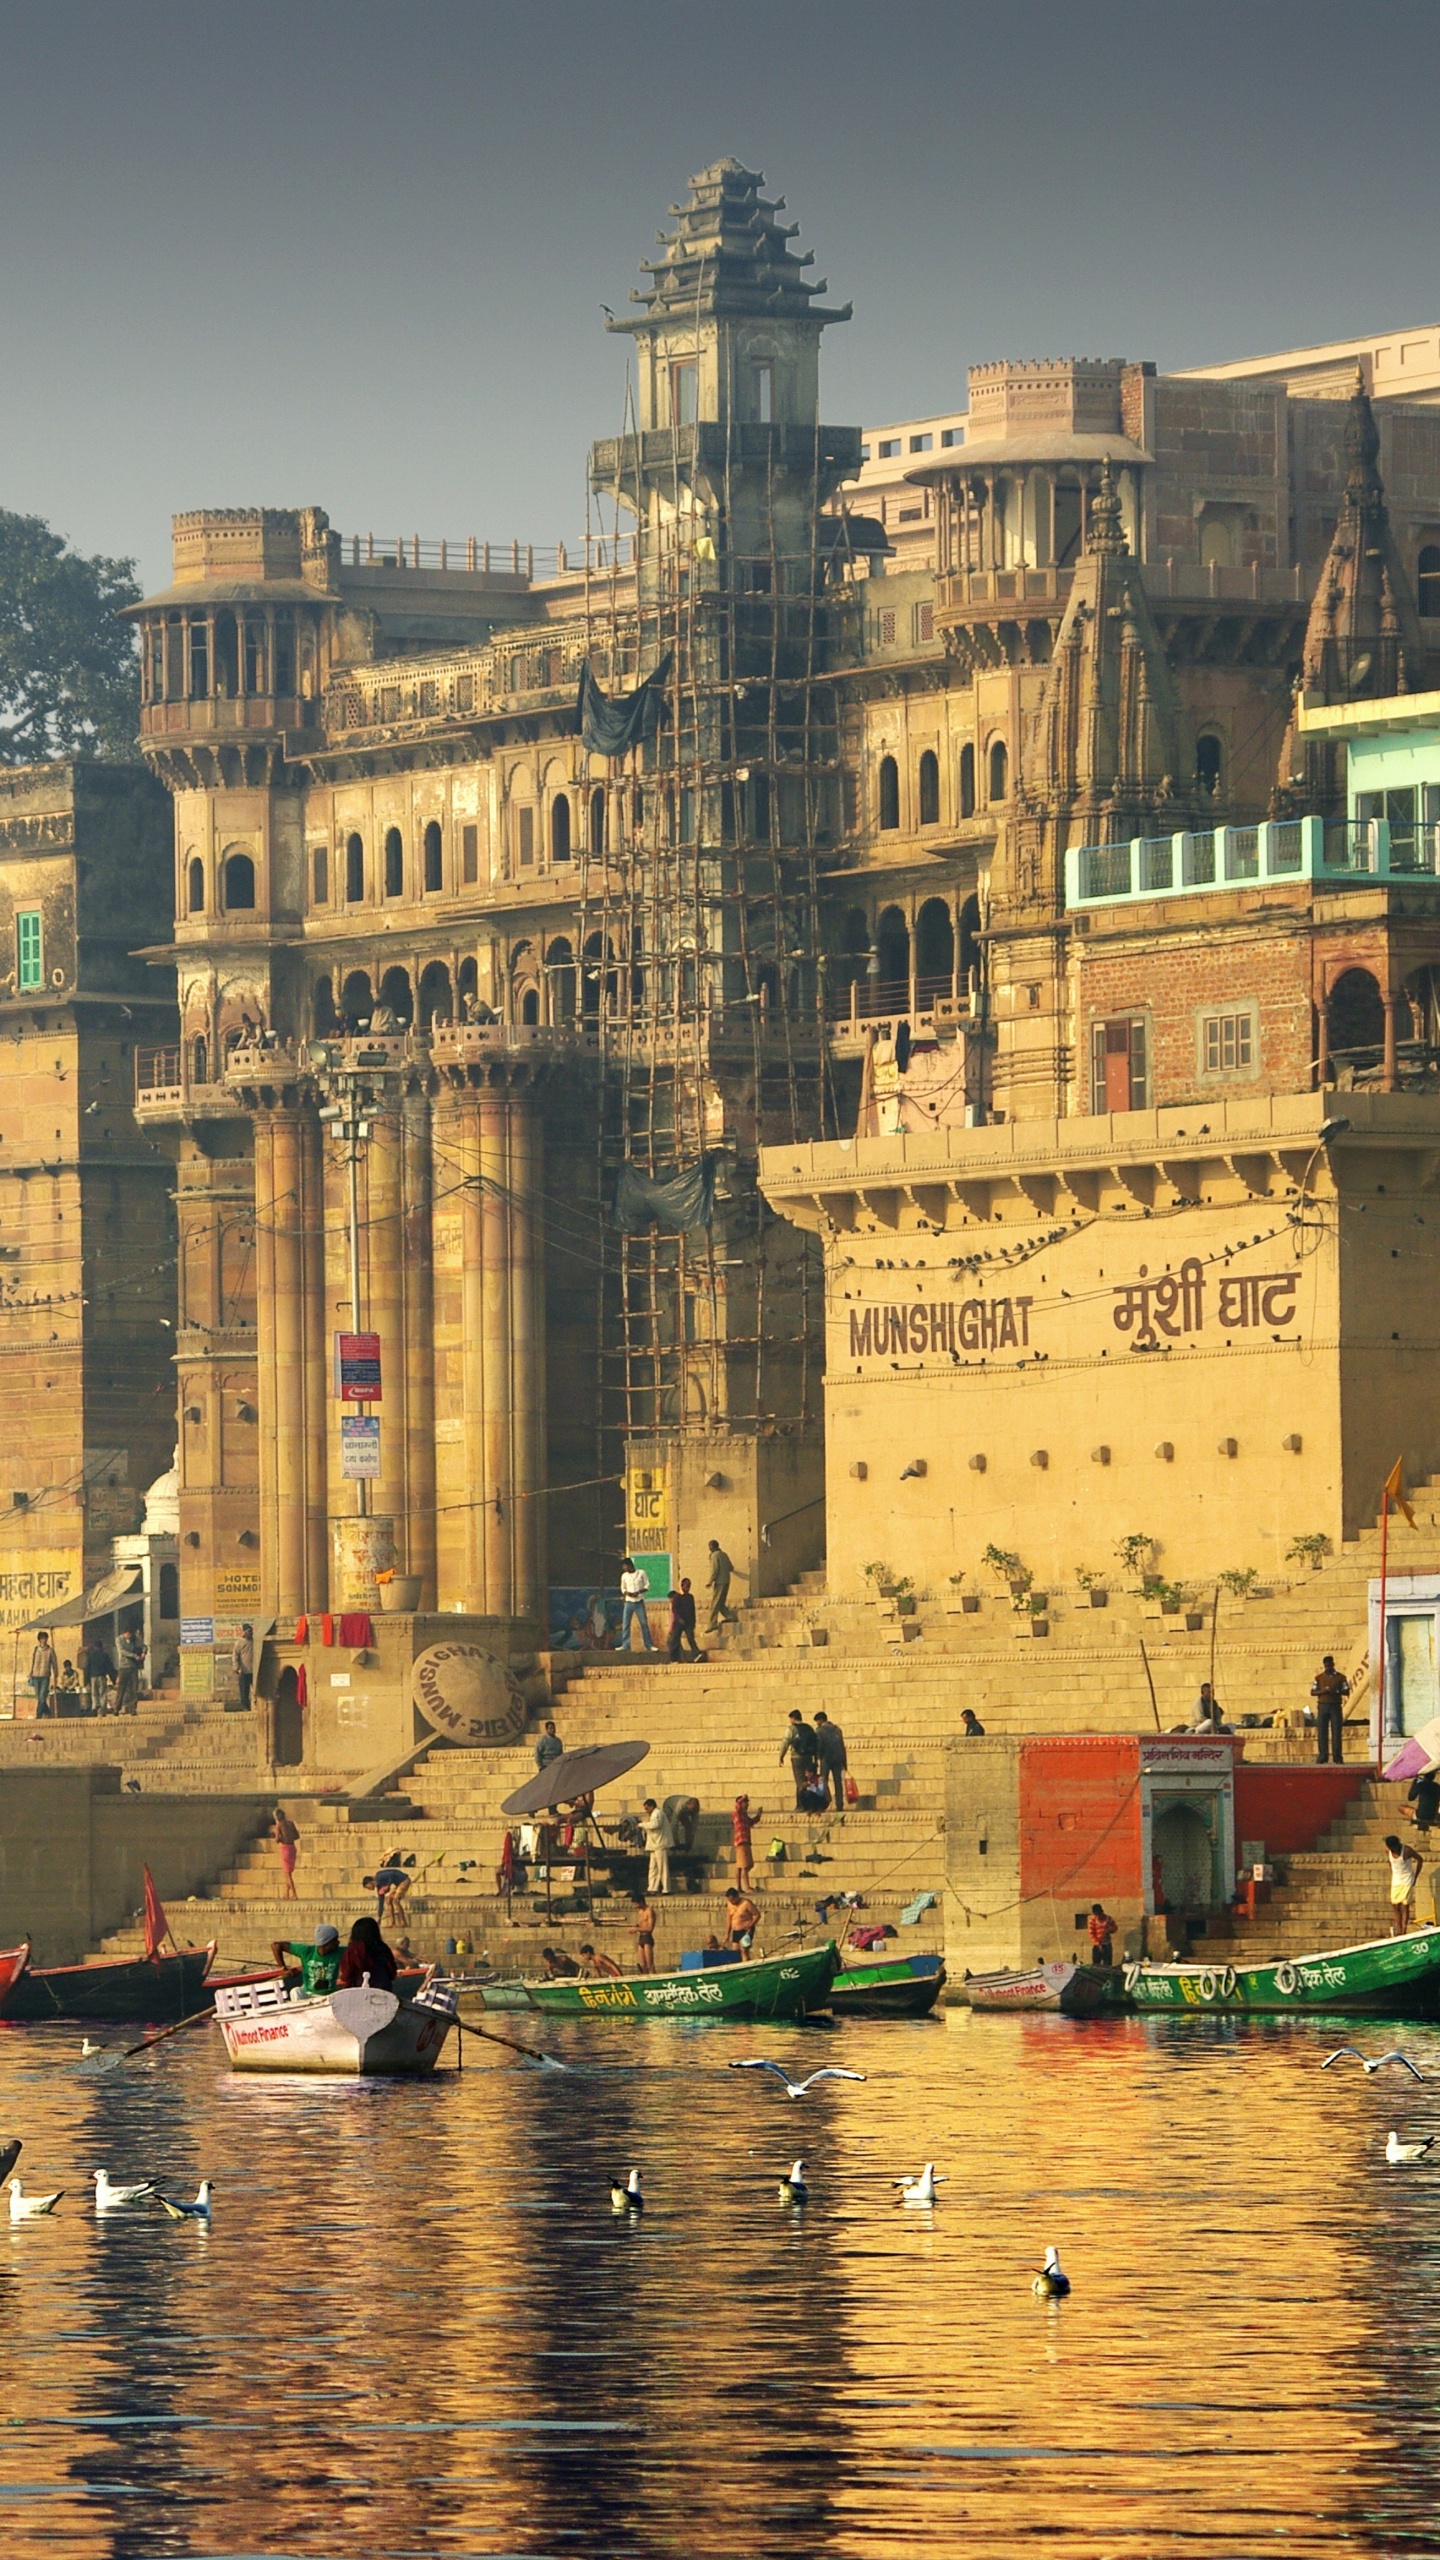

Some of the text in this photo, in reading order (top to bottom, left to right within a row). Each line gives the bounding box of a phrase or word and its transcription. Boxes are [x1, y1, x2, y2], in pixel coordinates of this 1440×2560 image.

[1113, 1257, 1303, 1353] मुंशी घाट
[634, 1490, 663, 1518] घाट
[1411, 1942, 1429, 1955] 30
[780, 1967, 800, 1979] 62
[1322, 1962, 1346, 1988] तेल
[696, 1977, 723, 2002] तेल
